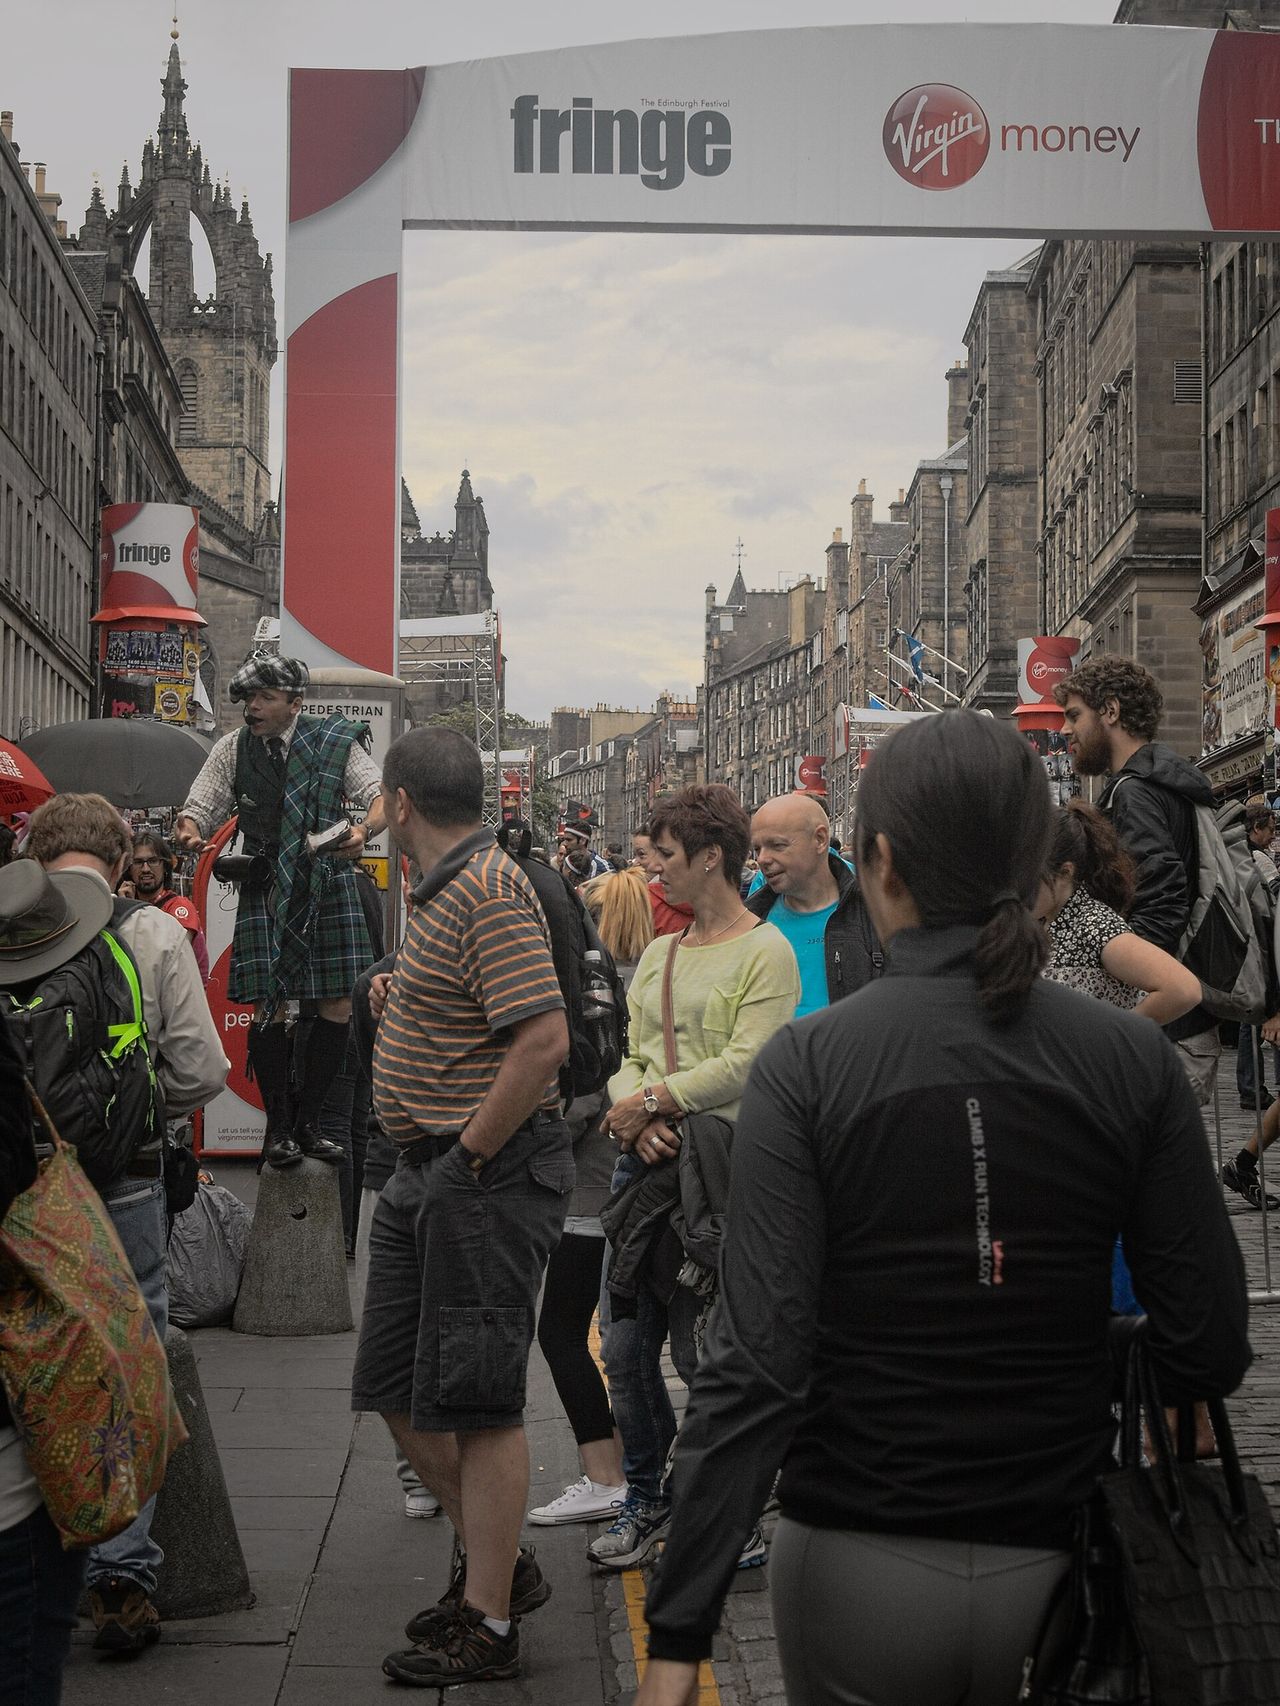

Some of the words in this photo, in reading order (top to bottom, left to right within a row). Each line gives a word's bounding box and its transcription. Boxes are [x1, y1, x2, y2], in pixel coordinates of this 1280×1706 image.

[641, 99, 655, 108] The
[657, 99, 699, 109] Edinburgh
[701, 99, 731, 108] Festival
[510, 94, 732, 191] fringe
[892, 94, 983, 177] Virgin
[1001, 123, 1142, 163] money
[119, 543, 171, 566] fringe
[301, 704, 384, 717] PEDESTRIAN
[966, 1097, 985, 1147] CLIMB
[973, 1148, 987, 1159] X
[974, 1161, 989, 1194] RUN
[976, 1195, 993, 1287] TECHNOLOGY
